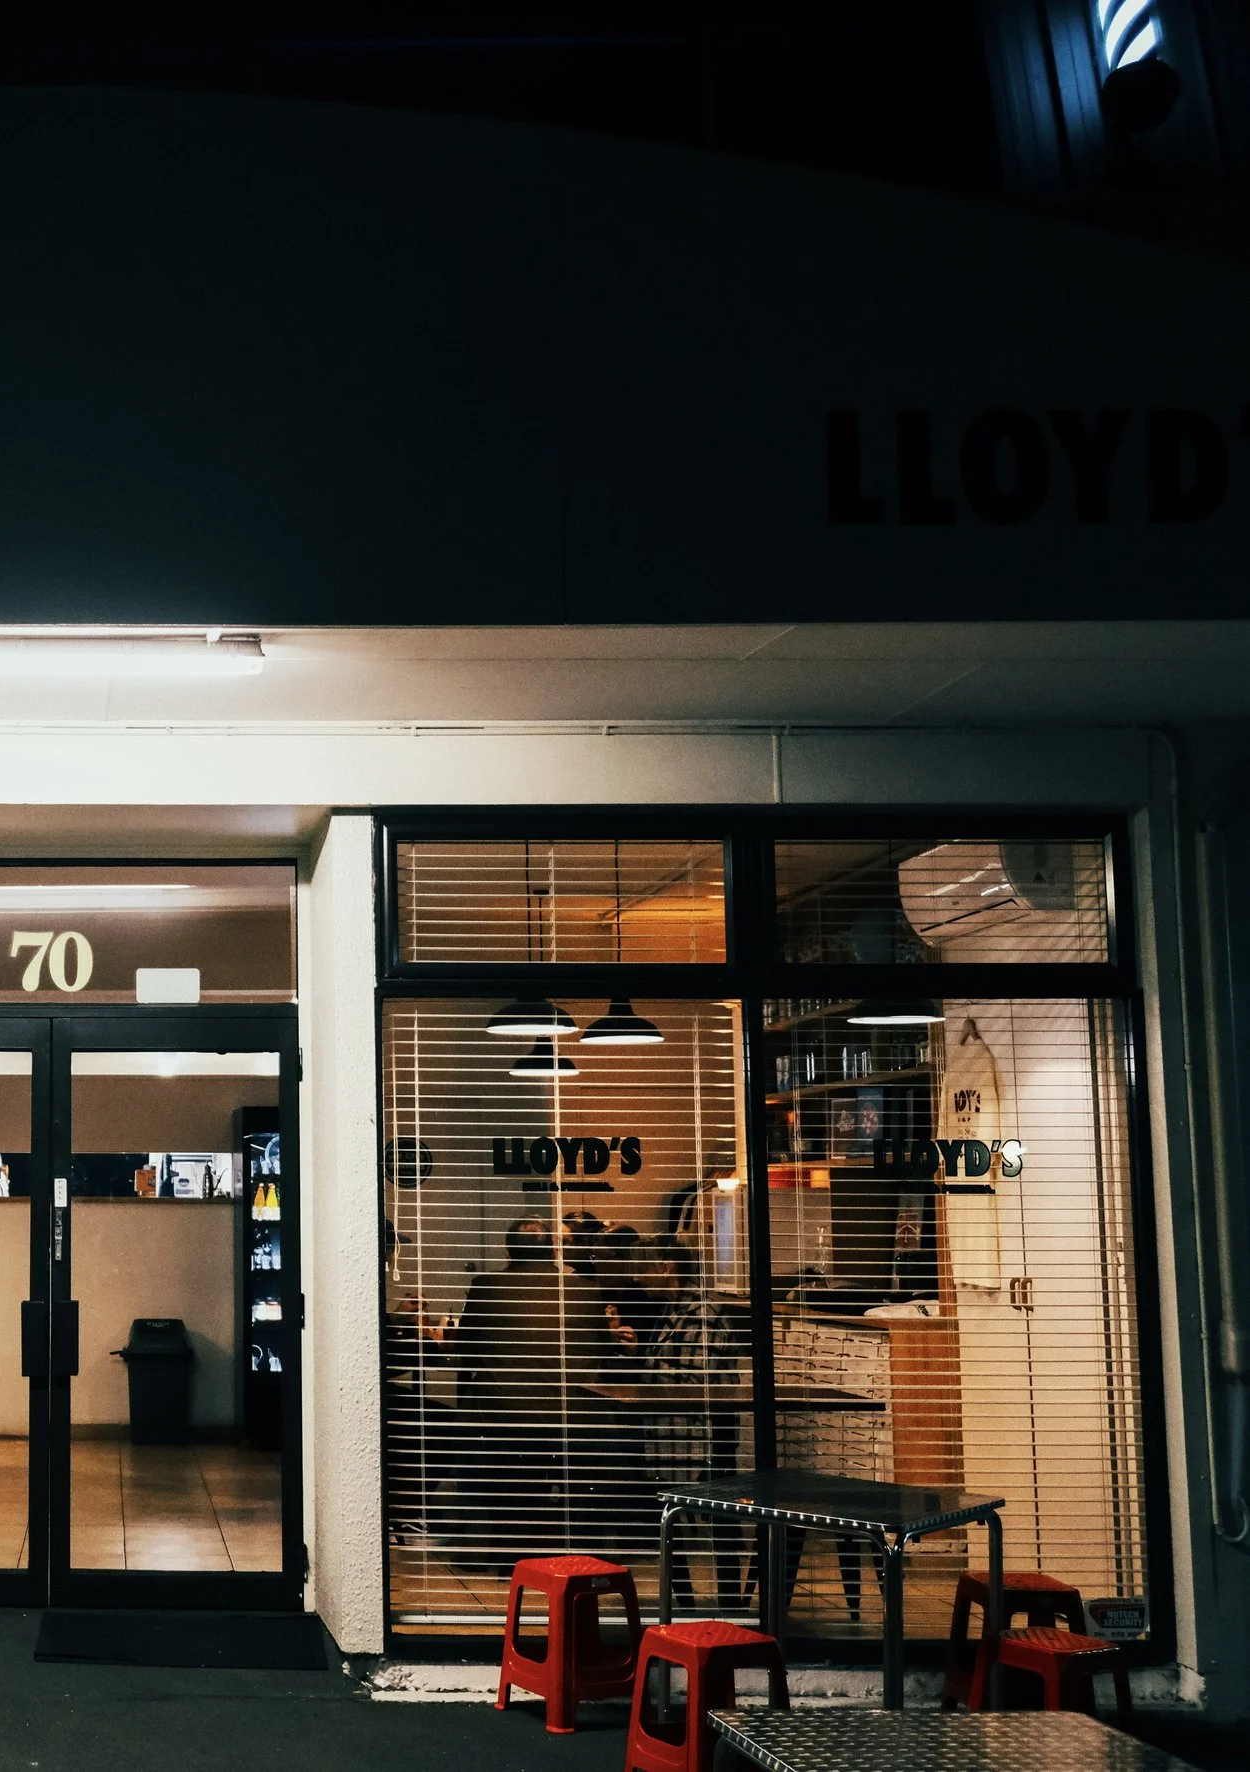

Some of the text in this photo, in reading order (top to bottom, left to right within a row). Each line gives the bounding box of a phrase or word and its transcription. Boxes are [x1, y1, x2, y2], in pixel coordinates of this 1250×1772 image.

[10, 931, 93, 992] 70
[493, 1137, 642, 1175] LLOYD'S
[873, 1139, 1023, 1177] LLOYD'S
